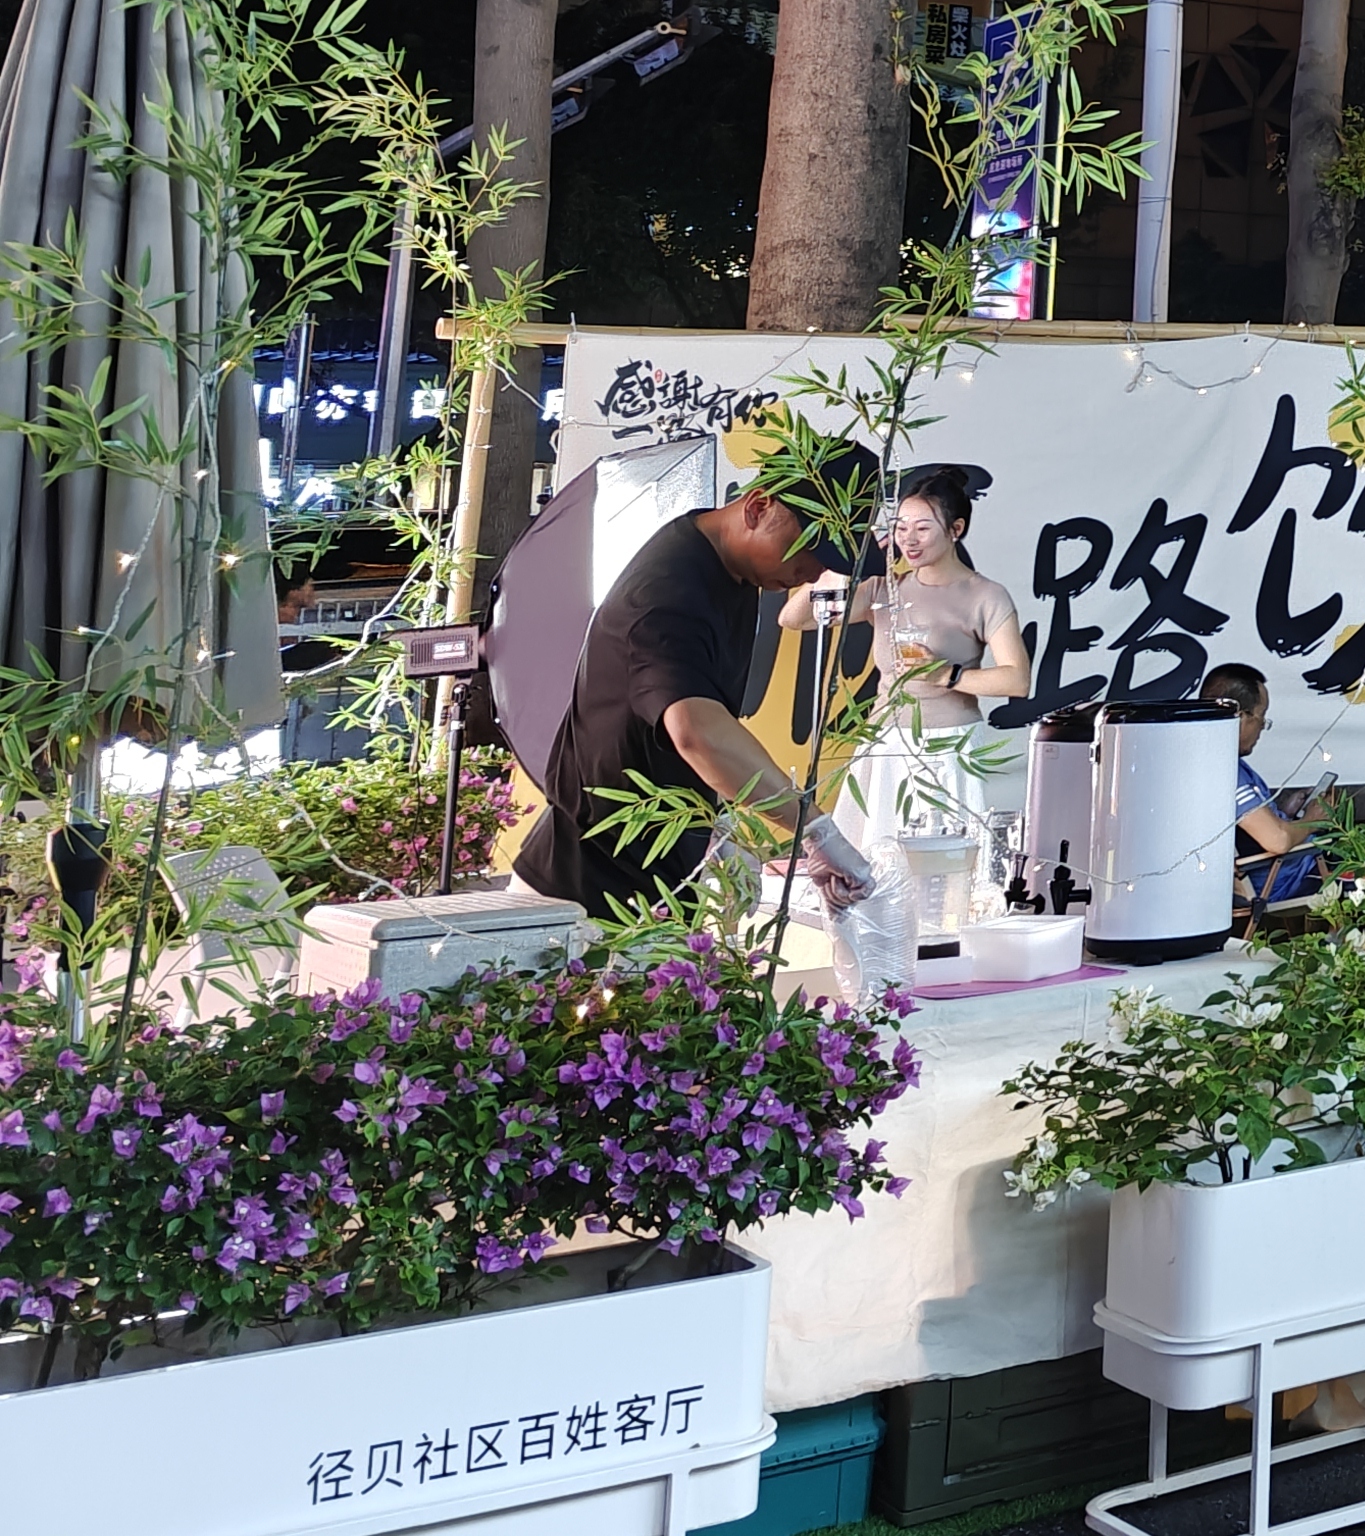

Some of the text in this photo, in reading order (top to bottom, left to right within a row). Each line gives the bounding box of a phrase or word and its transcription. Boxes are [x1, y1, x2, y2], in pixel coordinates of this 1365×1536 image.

[925, 3, 948, 65] 私房菜
[950, 6, 970, 57] 柴火灶
[306, 1383, 706, 1506] 径贝社区百姓客厅
